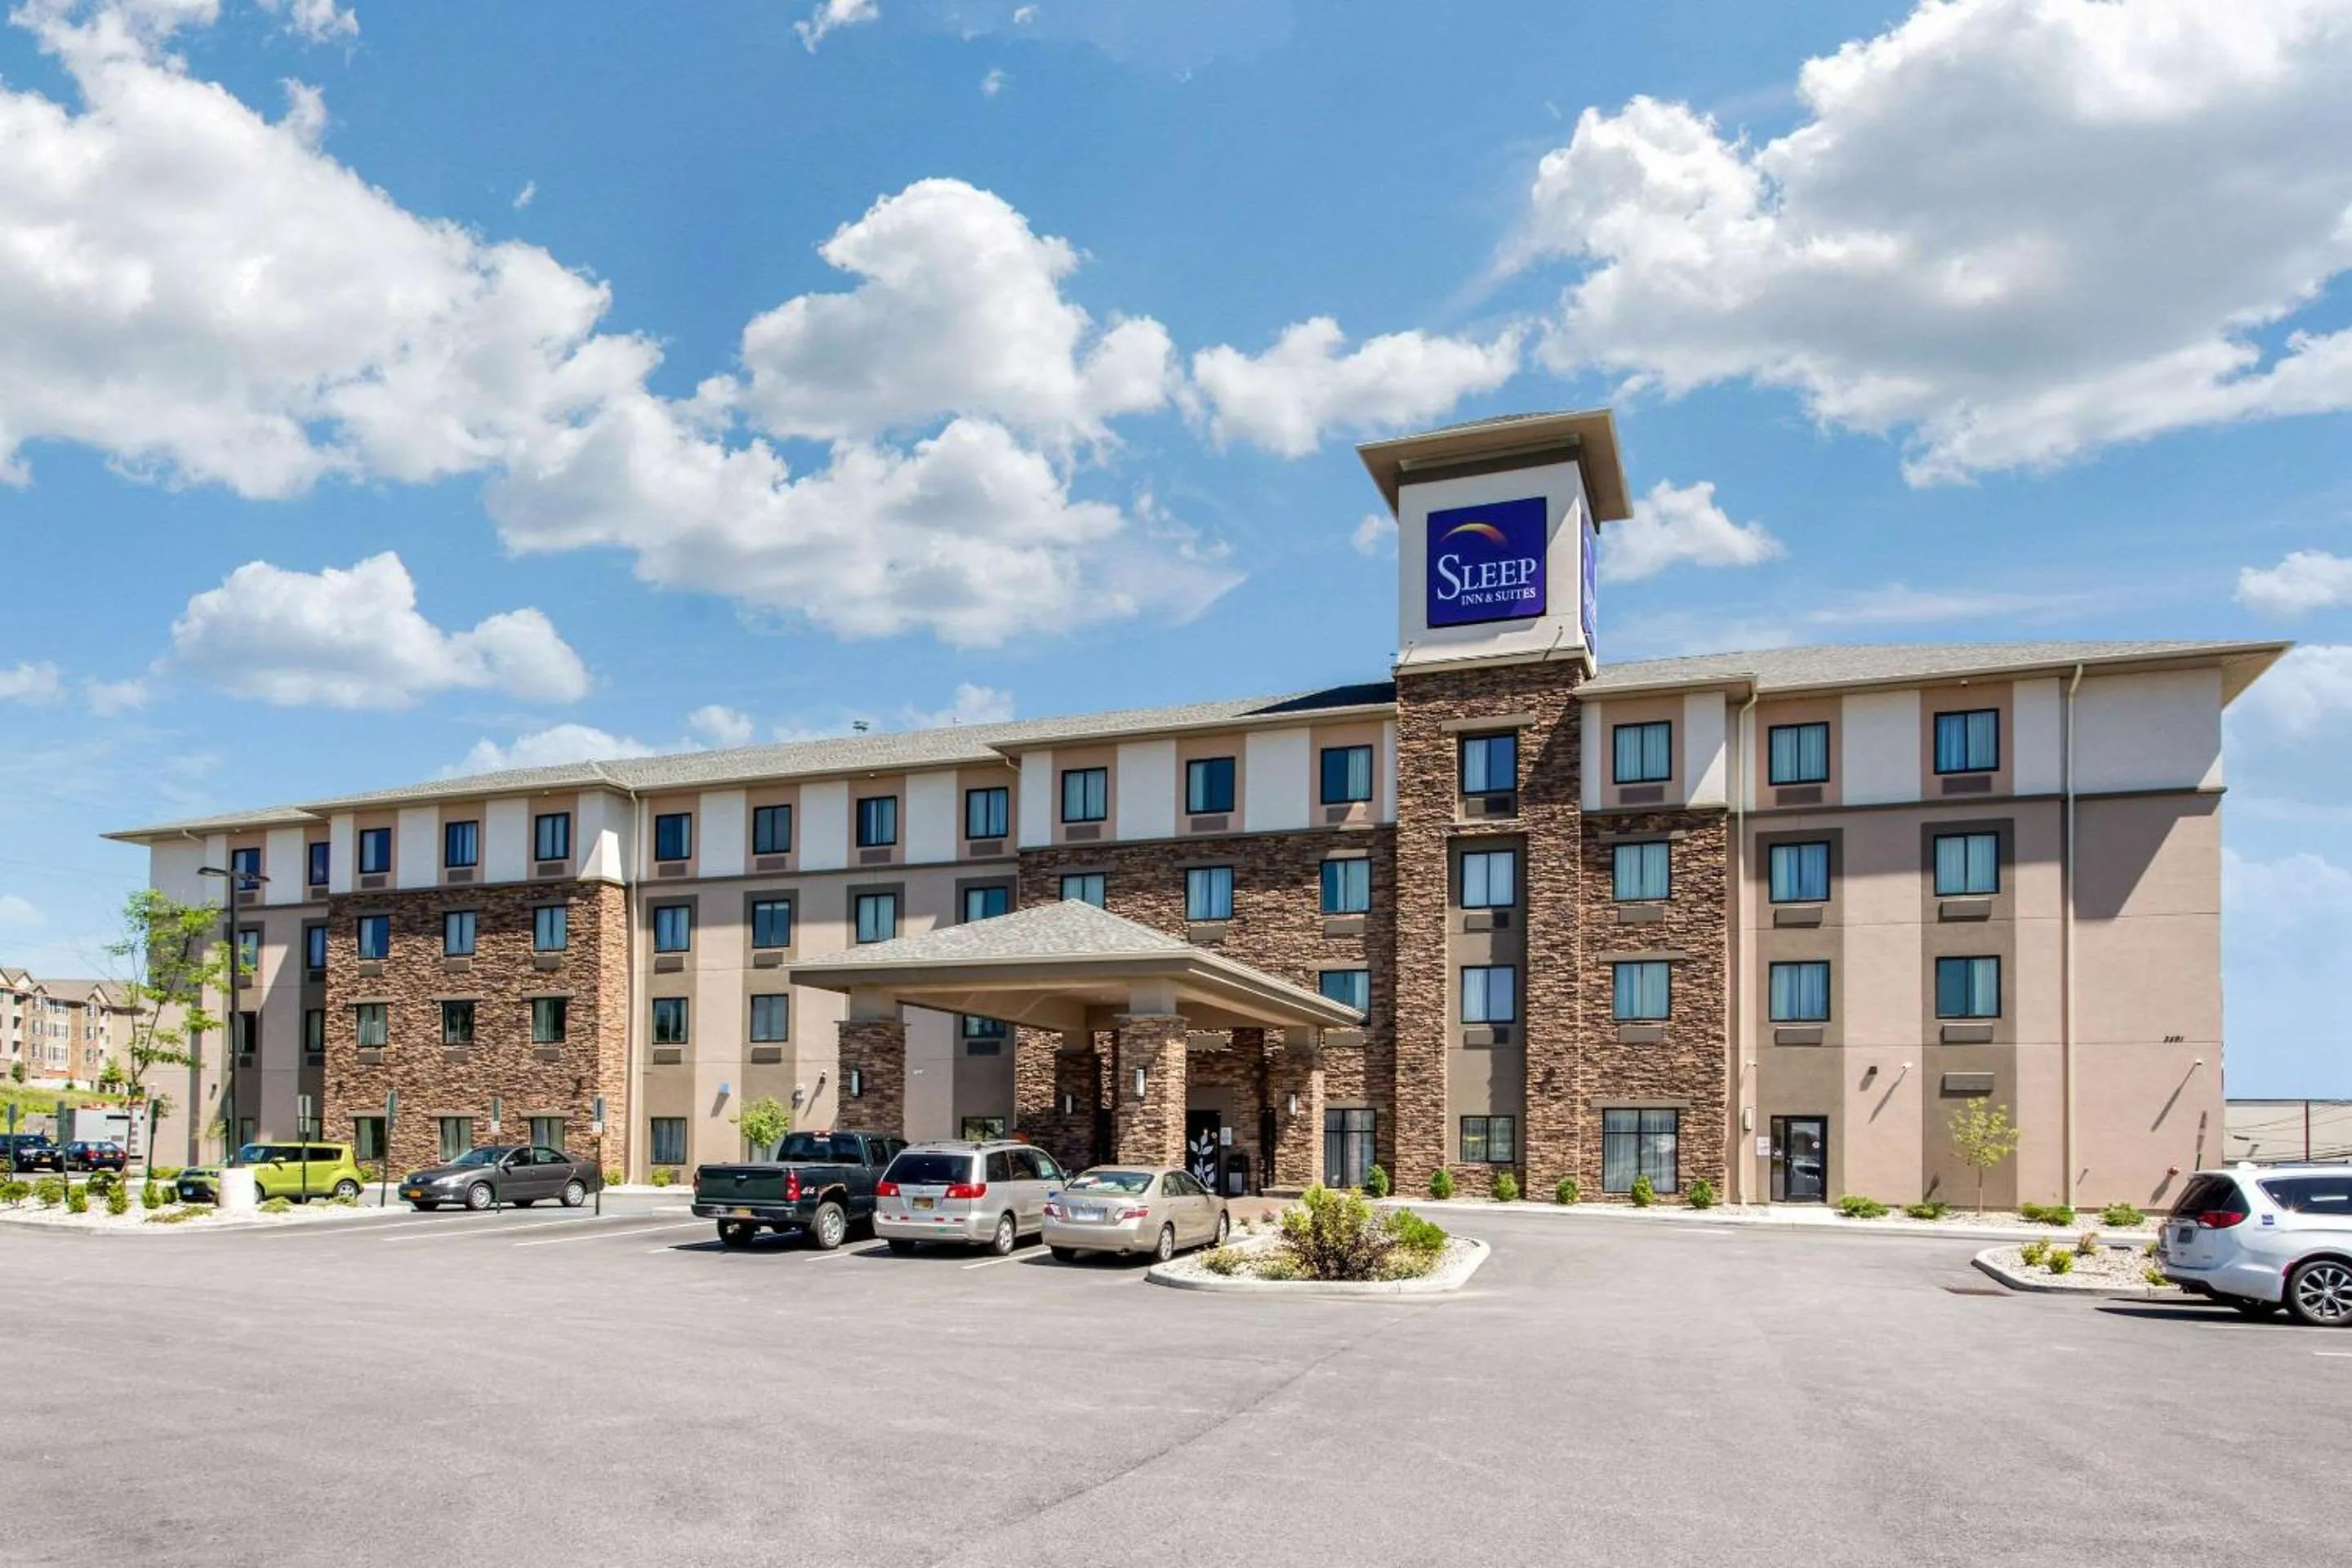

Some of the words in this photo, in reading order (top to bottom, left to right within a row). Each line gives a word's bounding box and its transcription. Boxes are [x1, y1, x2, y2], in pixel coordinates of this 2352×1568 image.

[1437, 554, 1537, 599] SLEEP
[1461, 593, 1484, 605] INN
[1485, 592, 1494, 603] &
[1495, 587, 1536, 601] SUITES
